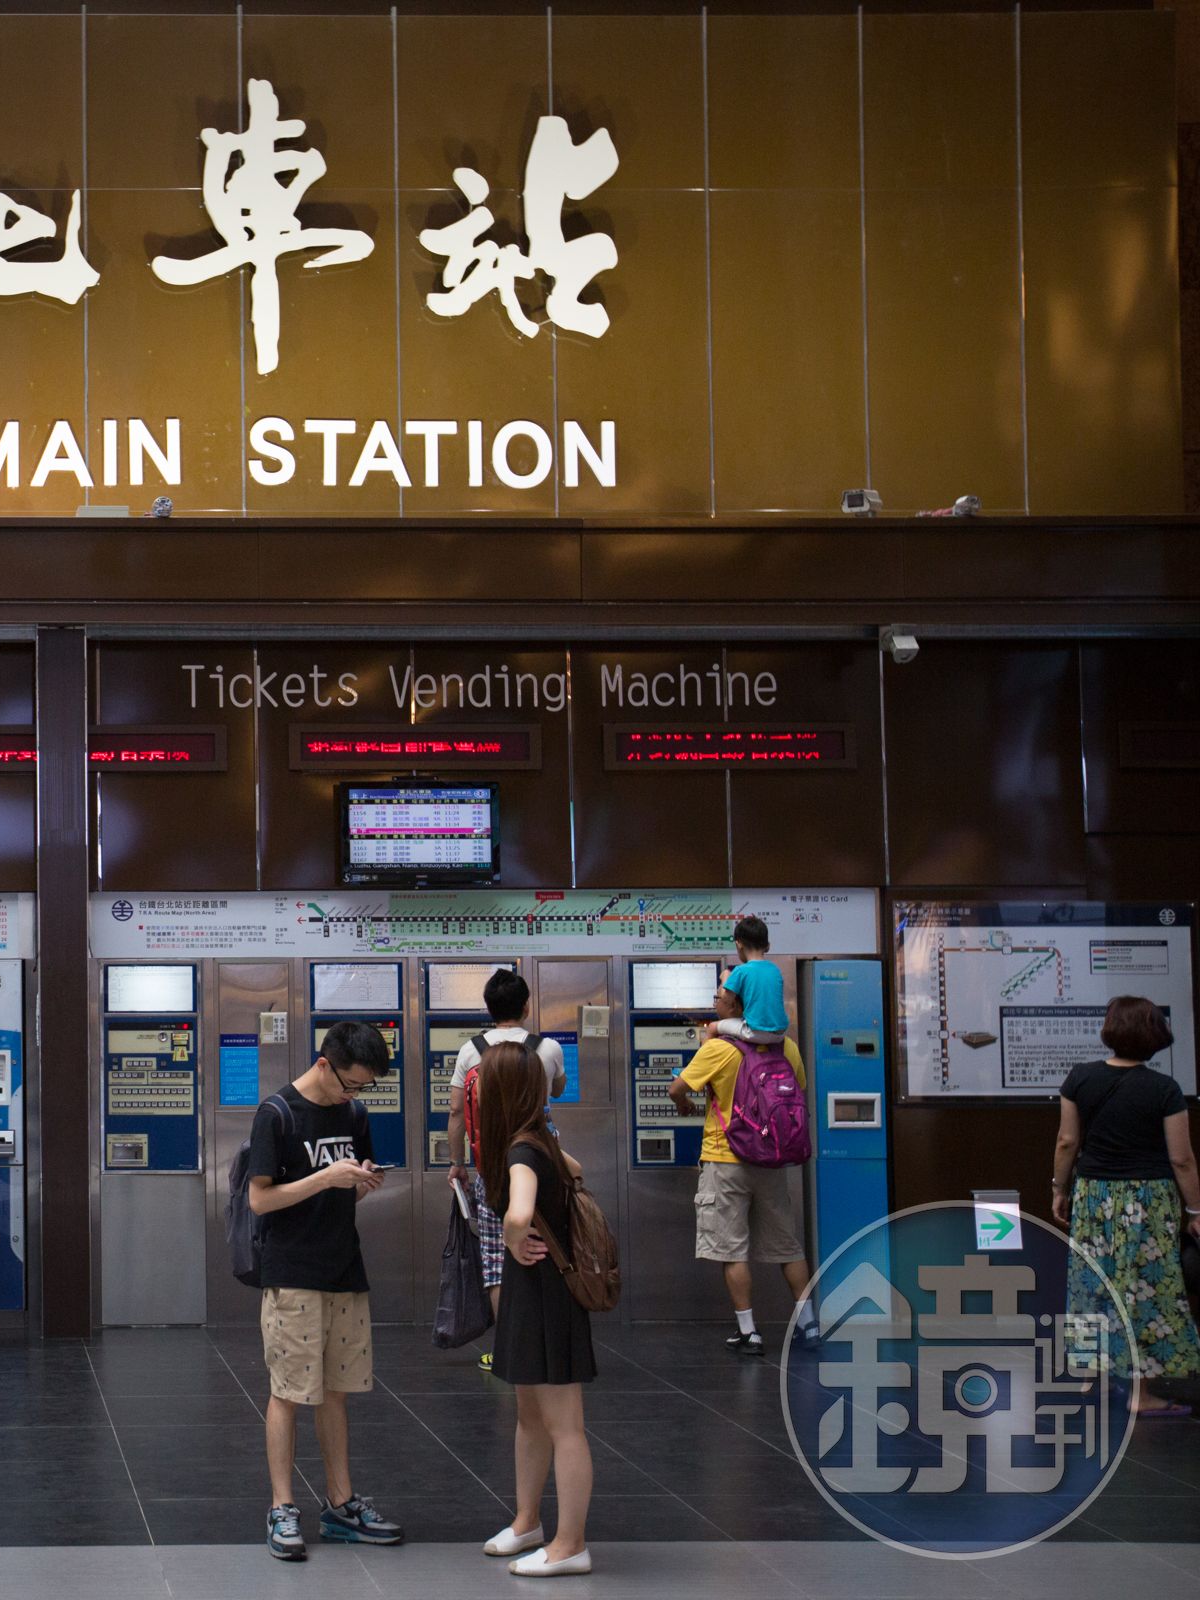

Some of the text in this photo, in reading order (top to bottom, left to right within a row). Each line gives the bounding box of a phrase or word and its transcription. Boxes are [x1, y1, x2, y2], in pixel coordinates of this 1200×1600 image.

[248, 417, 616, 488] STATION
[182, 664, 777, 712] Tickets Vending Machine
[304, 1136, 355, 1168] VANS
